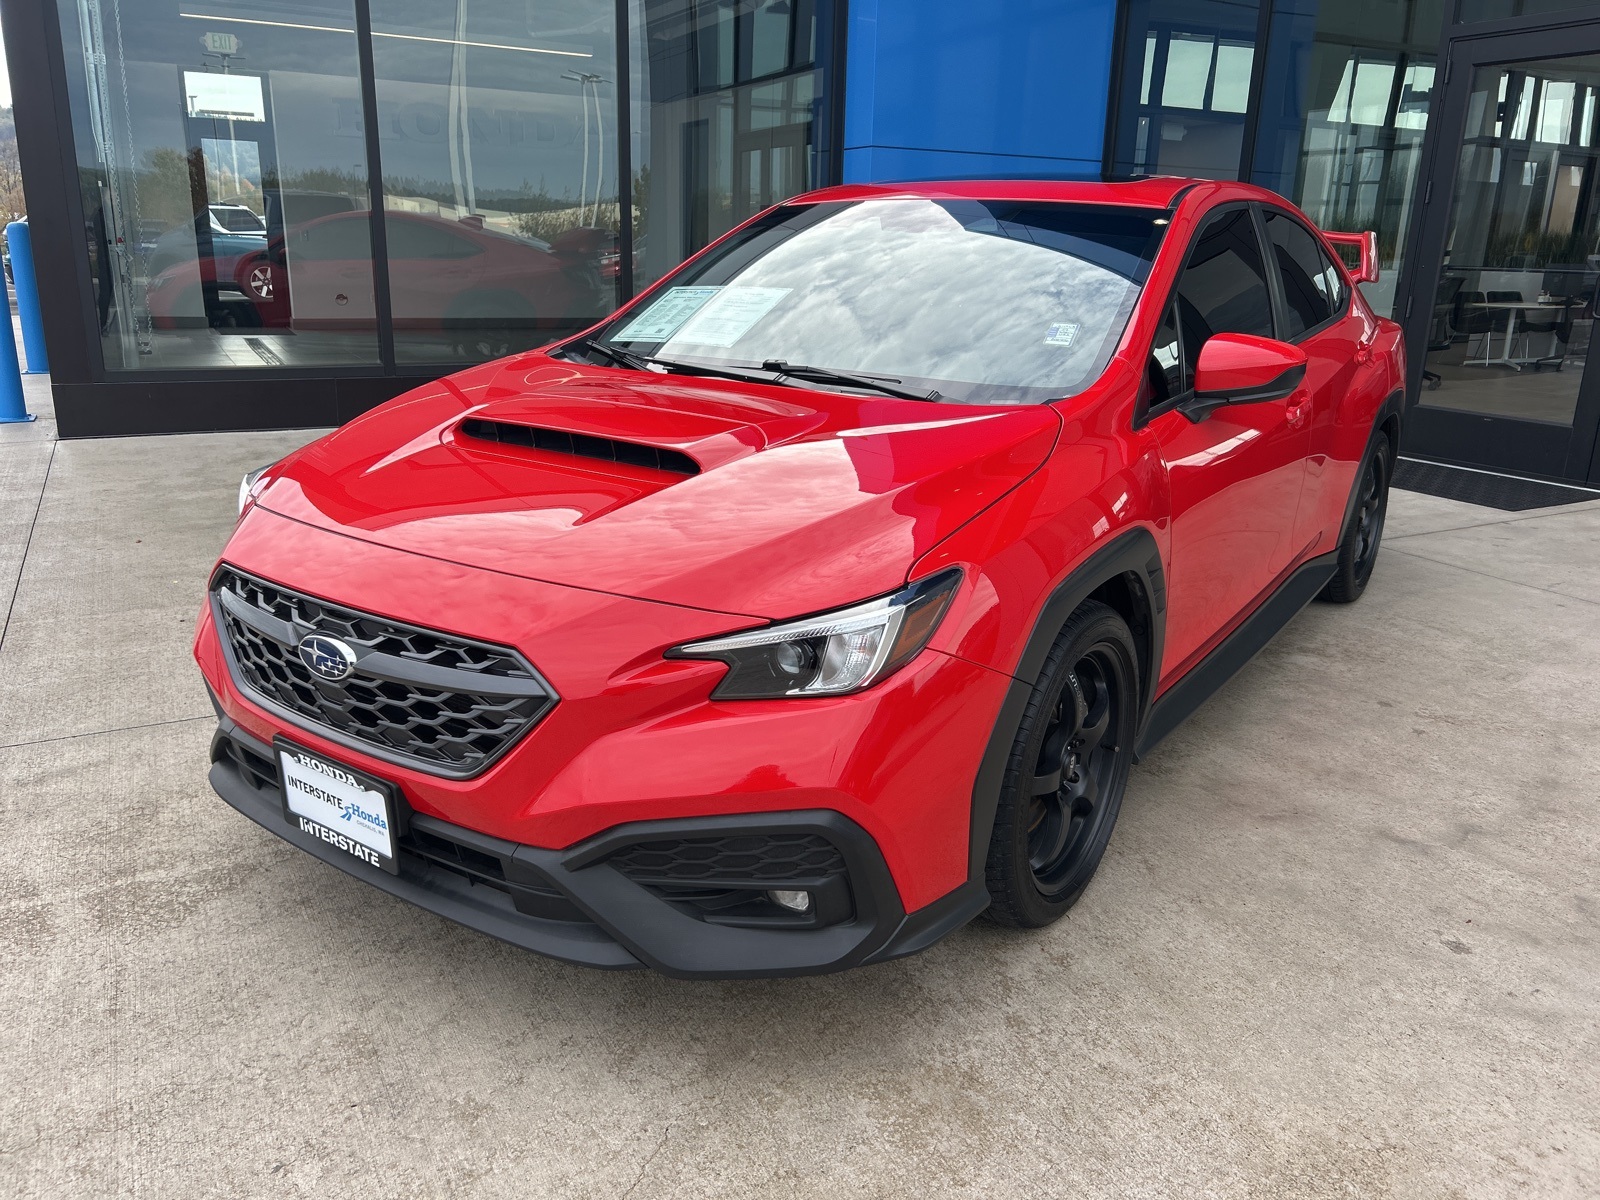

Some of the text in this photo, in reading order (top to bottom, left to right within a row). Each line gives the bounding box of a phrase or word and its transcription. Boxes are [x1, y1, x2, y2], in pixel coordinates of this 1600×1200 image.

[211, 34, 232, 51] EXIT
[298, 753, 359, 788] HONDA
[287, 774, 344, 810] INTERSTATE
[350, 803, 388, 830] Honda
[299, 817, 381, 868] INTERSTATE
